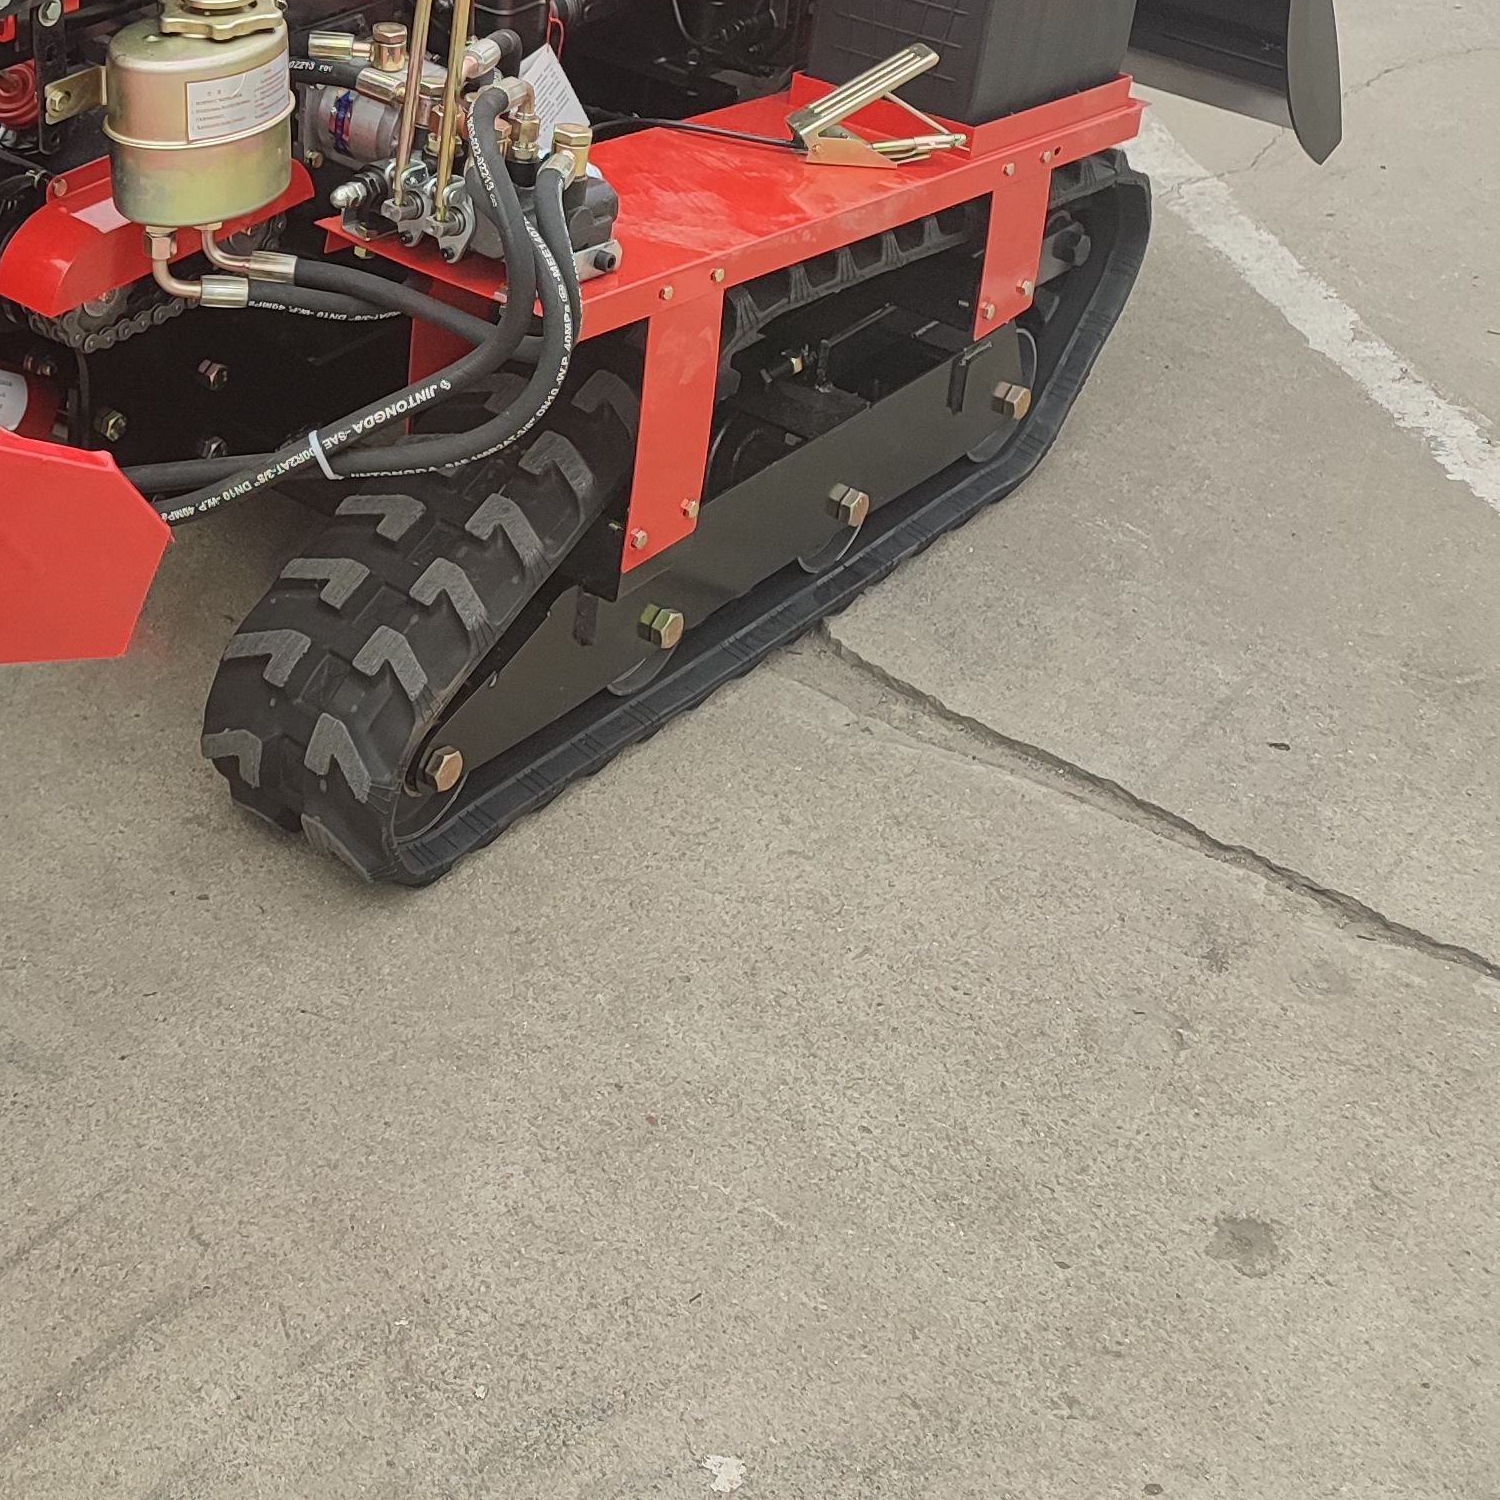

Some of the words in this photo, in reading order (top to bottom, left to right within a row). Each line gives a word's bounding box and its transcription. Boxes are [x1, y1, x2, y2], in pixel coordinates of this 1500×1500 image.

[351, 383, 438, 434] JINTONGDA
[254, 446, 318, 488] 00R2AT-3/8"
[222, 480, 253, 501] DN10
